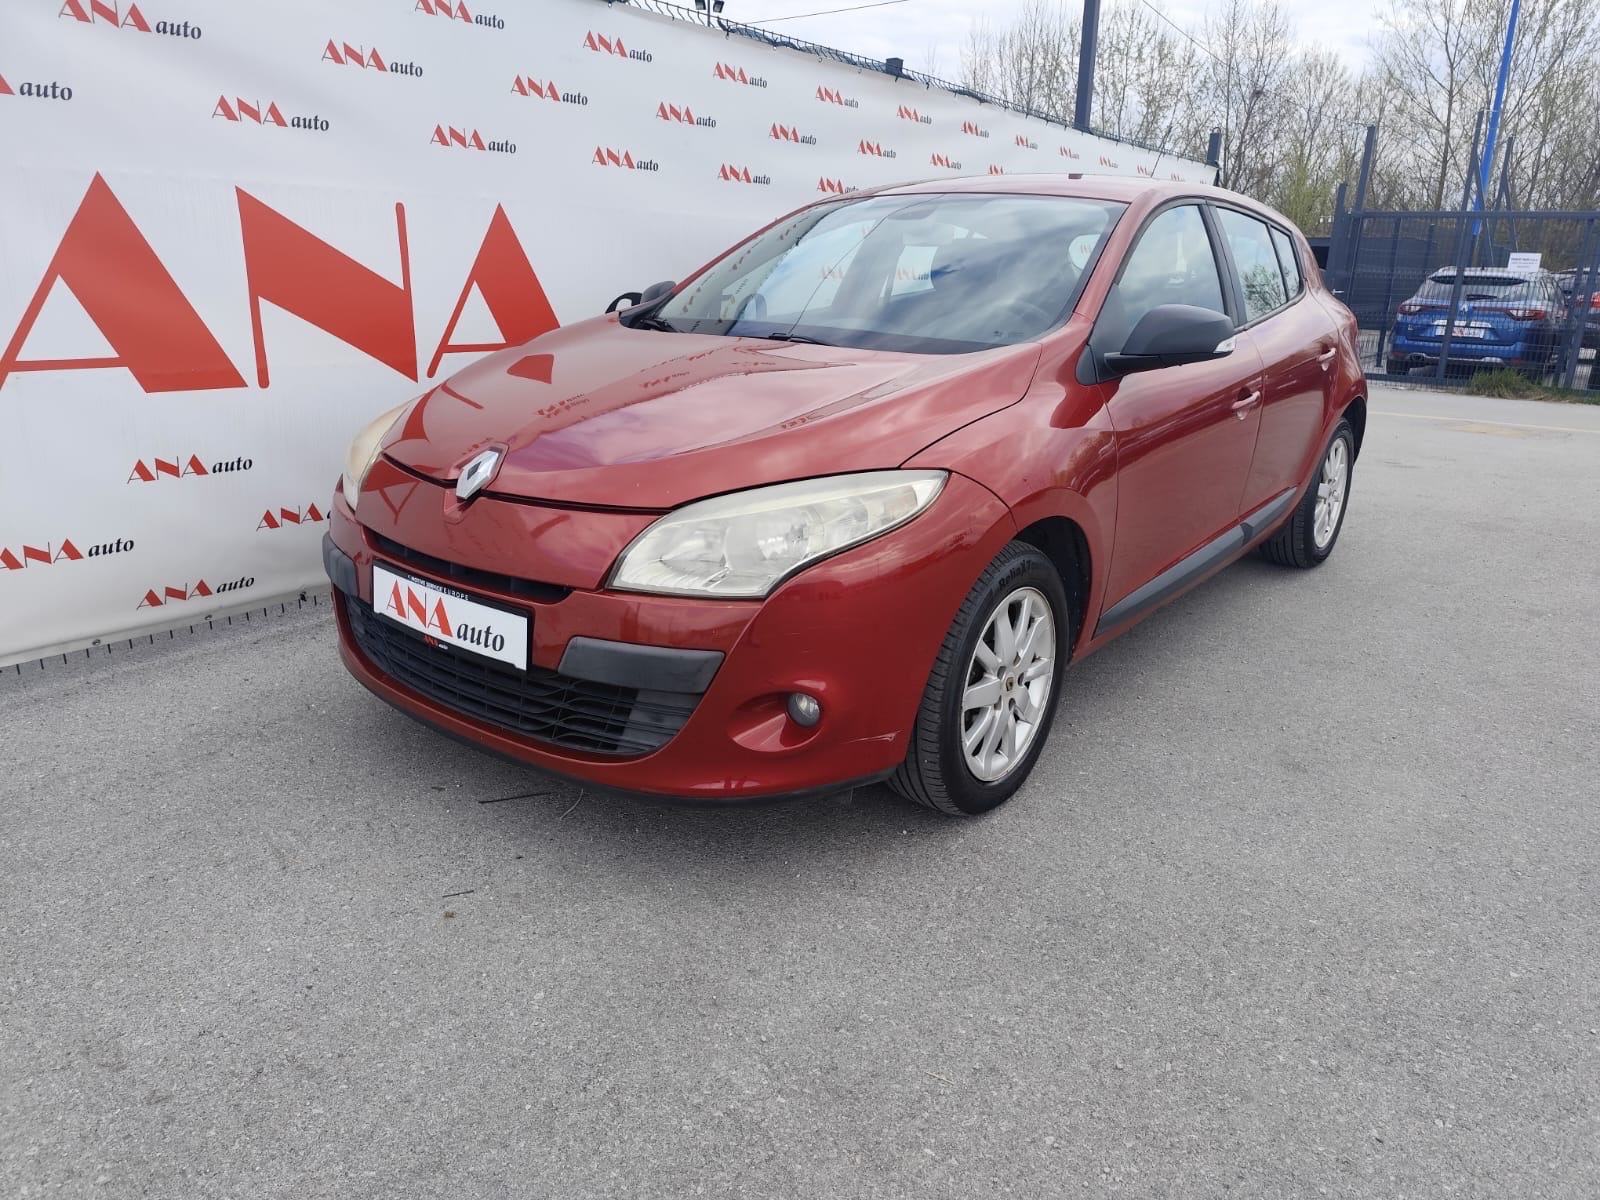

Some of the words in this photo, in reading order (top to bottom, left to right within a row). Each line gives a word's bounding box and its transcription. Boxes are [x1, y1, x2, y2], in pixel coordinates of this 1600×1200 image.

[58, 0, 152, 32] ANA
[156, 21, 201, 39] auto
[415, 0, 473, 24] ANA
[475, 15, 504, 29] auto
[322, 39, 387, 72] ANA
[390, 62, 423, 77] auto
[583, 30, 628, 58] ANA
[630, 50, 652, 62] auto
[713, 62, 748, 84] ANA
[749, 77, 767, 88] auto
[20, 82, 72, 100] auto
[511, 75, 560, 102] ANA
[563, 93, 588, 105] auto
[816, 85, 843, 105] ANA
[844, 98, 858, 108] auto
[212, 95, 288, 127] ANA
[291, 115, 329, 131] auto
[656, 102, 695, 125] ANA
[696, 116, 716, 128] auto
[897, 105, 919, 122] ANA
[430, 124, 486, 151] ANA
[488, 140, 516, 153] auto
[769, 123, 799, 143] ANA
[801, 135, 816, 145] auto
[858, 139, 882, 157] ANA
[883, 149, 896, 158] auto
[592, 146, 635, 169] ANA
[637, 160, 658, 171] auto
[930, 153, 950, 168] ANA
[718, 163, 752, 183] ANA
[753, 175, 770, 185] auto
[817, 176, 844, 194] ANA
[0, 170, 560, 393] ANA
[127, 454, 209, 484] ANA
[212, 457, 252, 473] auto
[256, 502, 324, 531] ANA
[0, 539, 84, 570] ANA
[88, 538, 134, 557] auto
[137, 579, 213, 610] ANA
[217, 577, 254, 593] auto
[443, 587, 469, 601] EUROPE
[386, 579, 454, 638] ANA
[457, 623, 505, 652] auto
